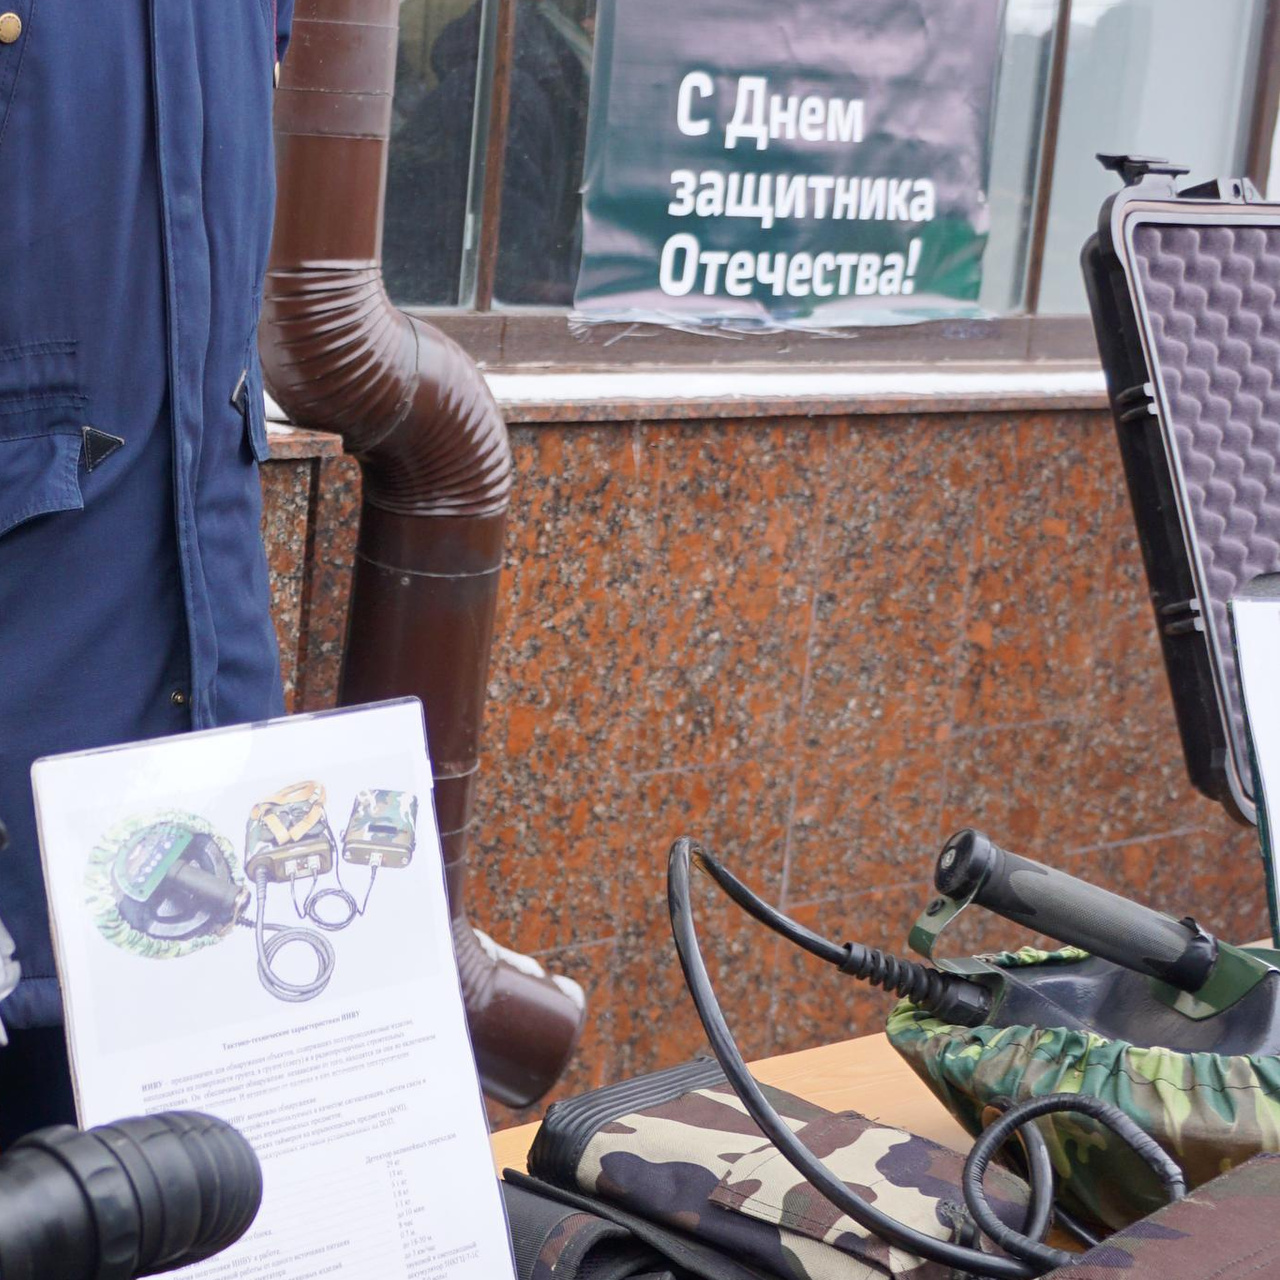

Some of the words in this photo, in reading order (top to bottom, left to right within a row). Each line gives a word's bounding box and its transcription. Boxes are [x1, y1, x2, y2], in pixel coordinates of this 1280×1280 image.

[676, 70, 715, 136] С
[724, 76, 864, 150] Днем
[667, 169, 936, 229] защитника
[658, 232, 922, 297] Отечества!
